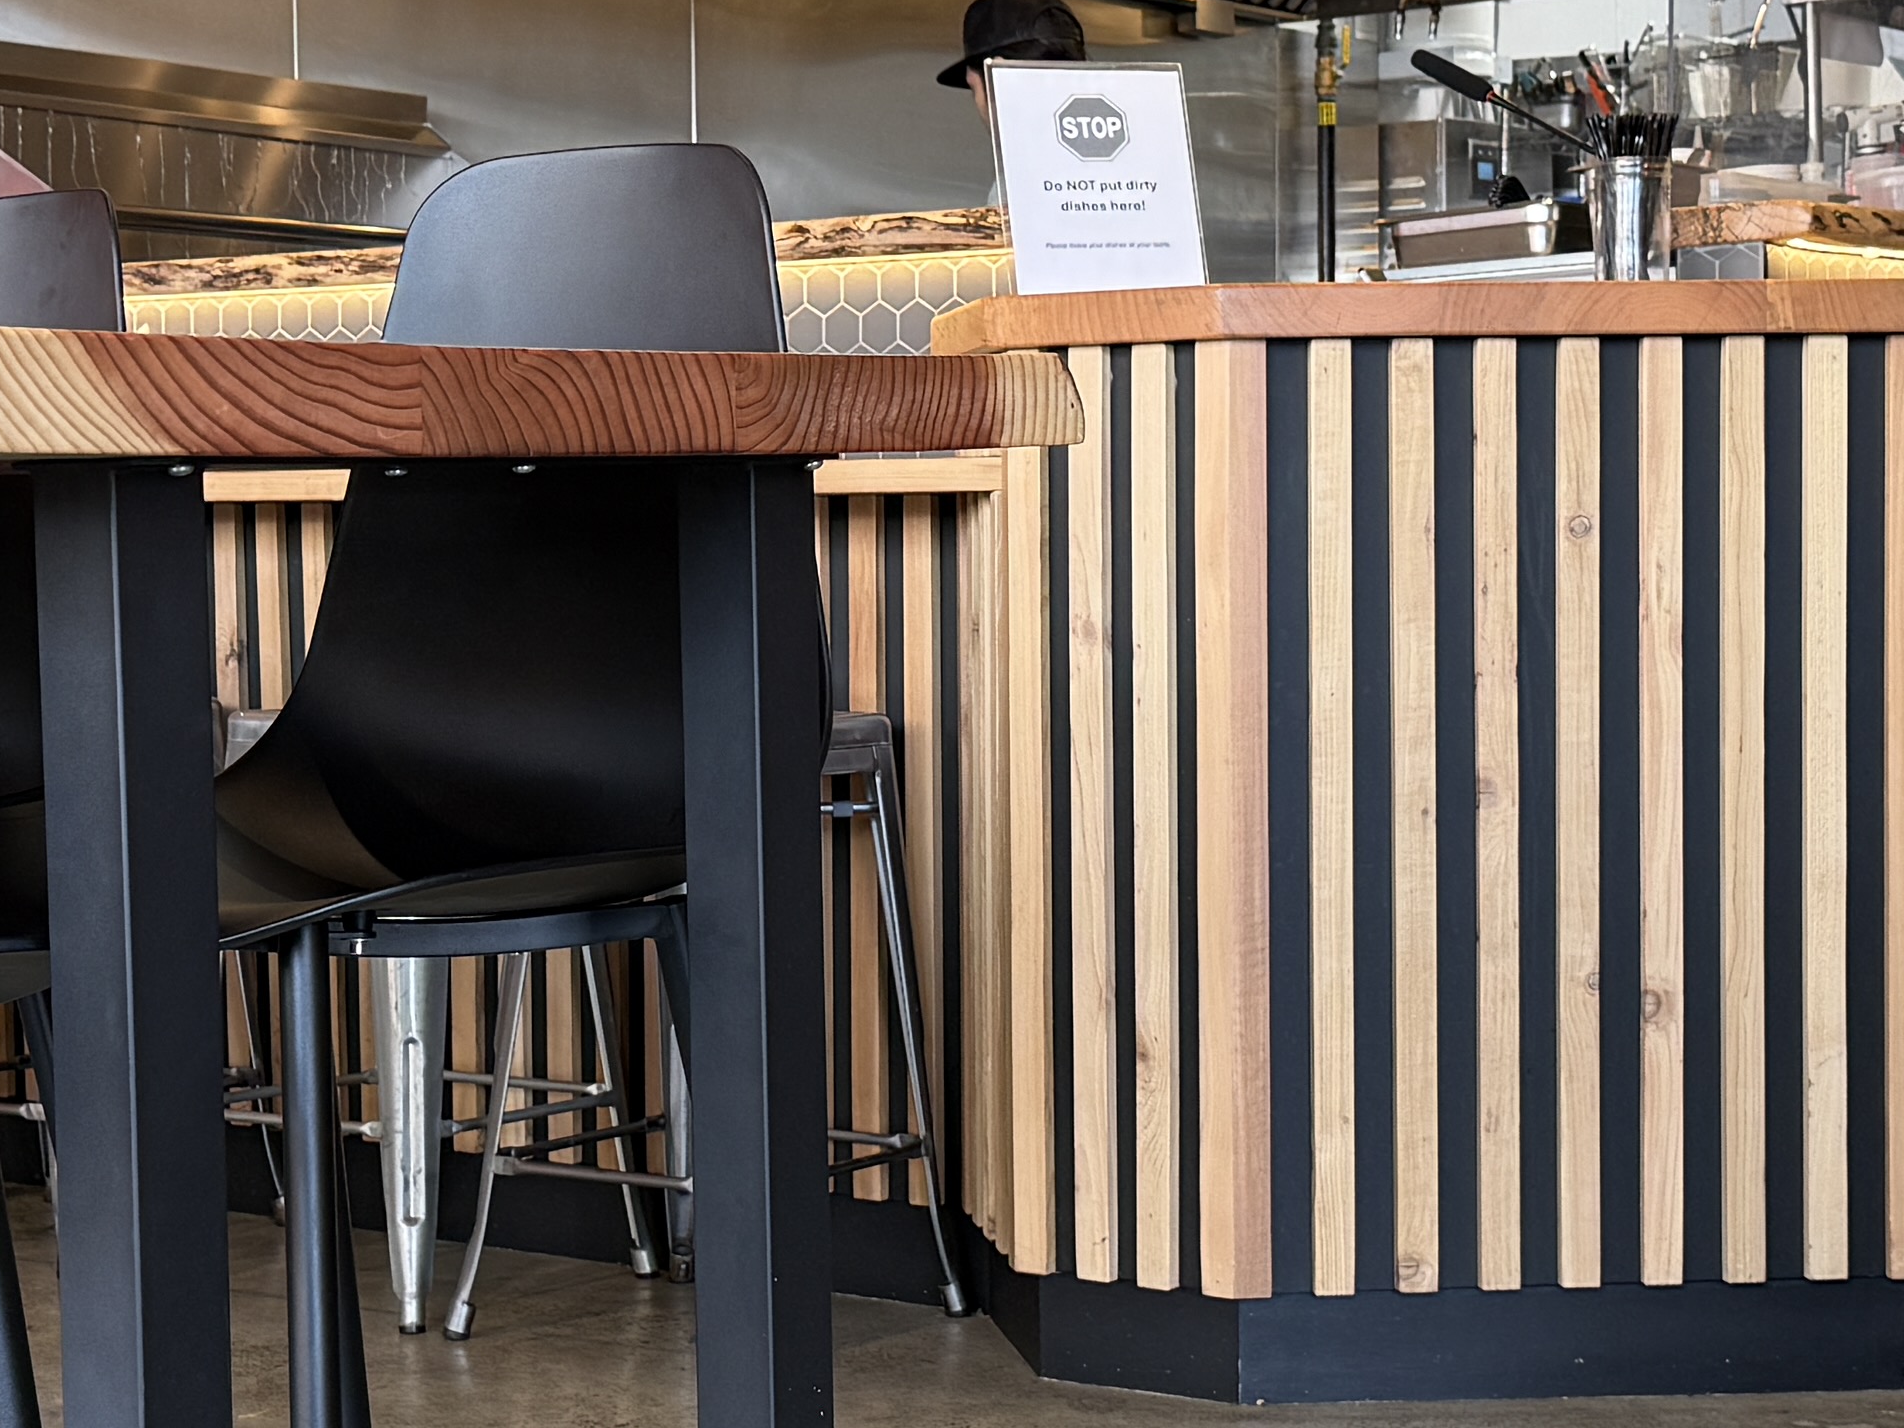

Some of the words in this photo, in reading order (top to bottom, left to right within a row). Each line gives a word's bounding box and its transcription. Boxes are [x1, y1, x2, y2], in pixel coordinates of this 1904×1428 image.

[1061, 116, 1122, 140] STOP
[1043, 180, 1062, 192] Do
[1066, 180, 1096, 191] NOT
[1100, 181, 1122, 193] put
[1126, 180, 1157, 192] dirty
[1061, 200, 1107, 212] dishes
[1111, 200, 1146, 212] here!
